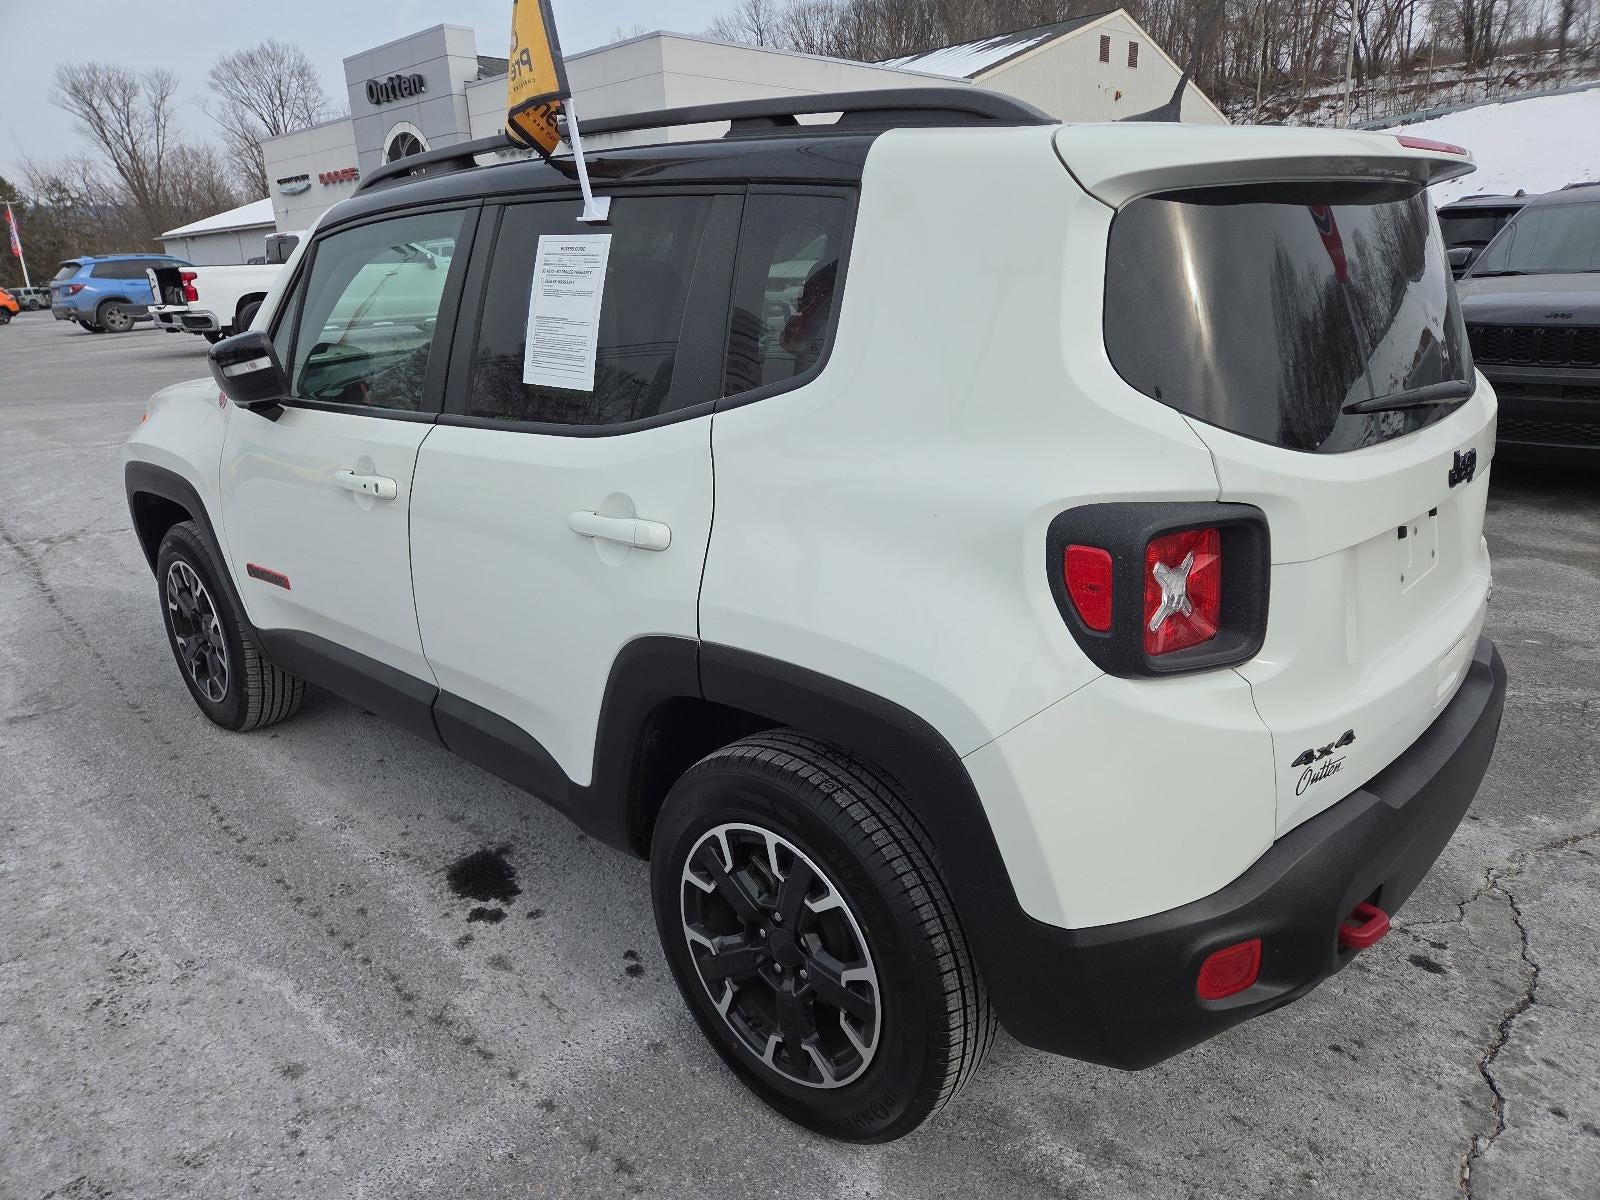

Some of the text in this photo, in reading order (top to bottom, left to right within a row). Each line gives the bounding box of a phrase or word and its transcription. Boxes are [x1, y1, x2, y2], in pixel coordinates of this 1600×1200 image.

[366, 74, 424, 105] Outten
[1449, 448, 1476, 488] Jeep
[1291, 729, 1356, 768] 4x4
[1296, 755, 1346, 796] Outten
